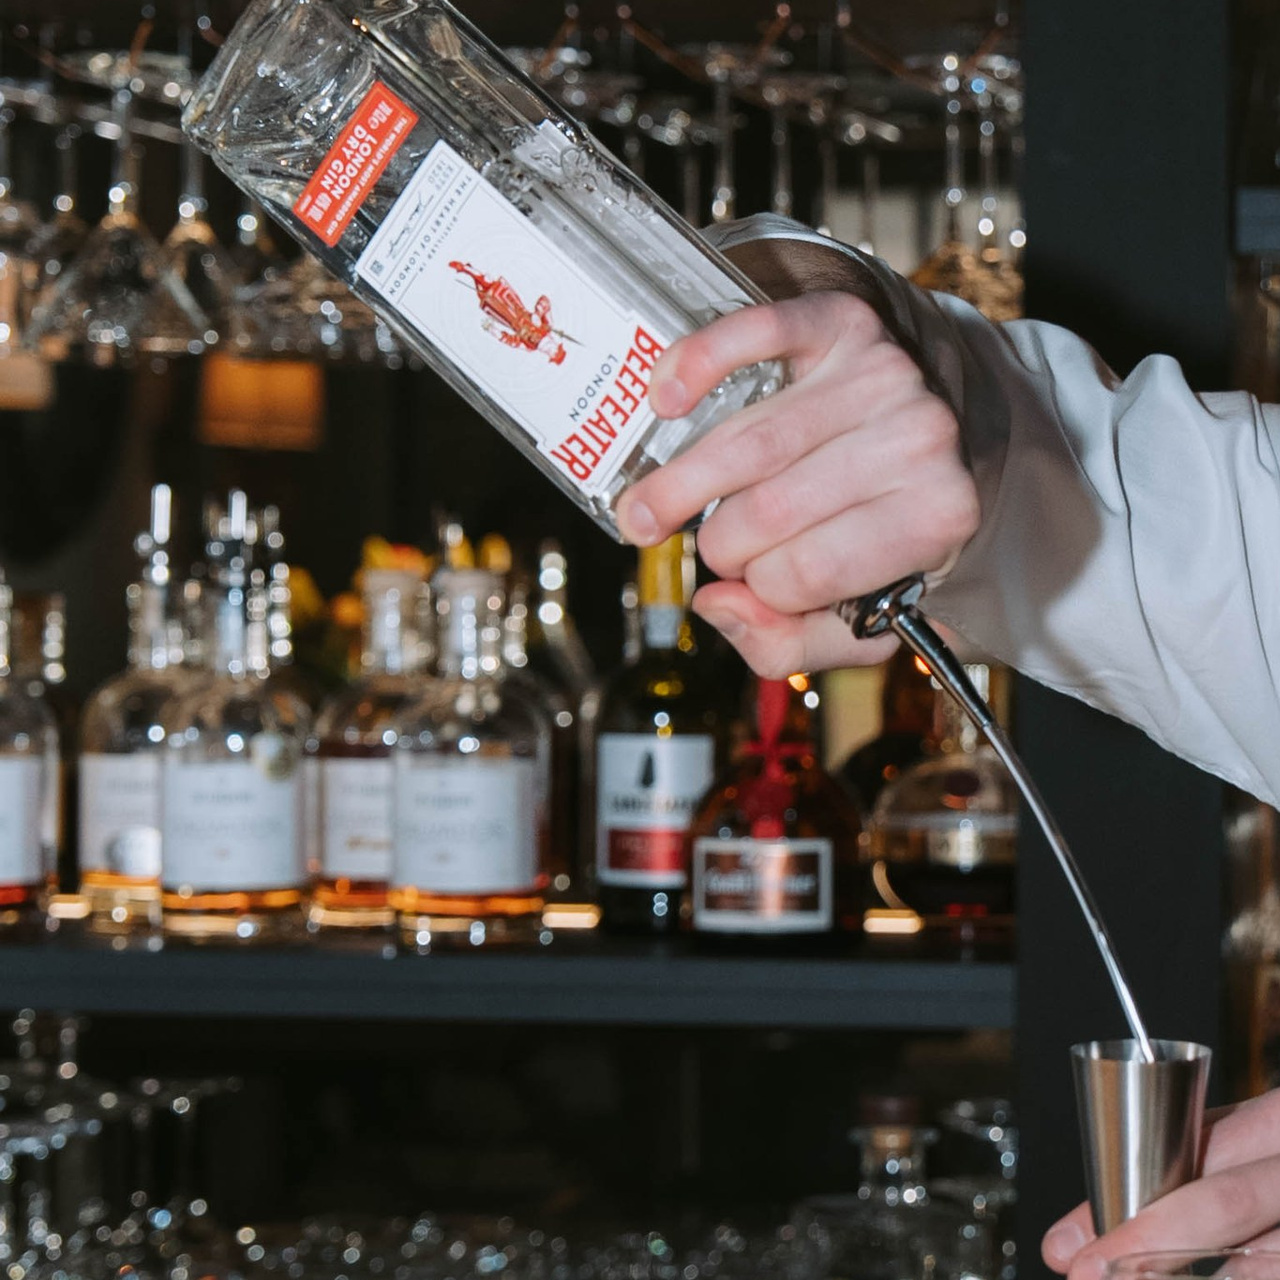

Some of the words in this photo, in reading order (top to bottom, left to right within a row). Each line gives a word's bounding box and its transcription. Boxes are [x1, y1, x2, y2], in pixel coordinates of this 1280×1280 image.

[341, 125, 367, 160] DRY
[395, 117, 408, 134] THE
[371, 133, 396, 165] WORLD'S
[320, 159, 344, 190] GIN
[331, 134, 378, 200] LONDON
[361, 165, 375, 187] MOST
[456, 175, 472, 196] THE
[337, 185, 361, 221] AWARDED
[432, 199, 454, 233] HEART
[326, 220, 339, 236] GIN
[420, 235, 431, 249] OF
[427, 216, 458, 260] DISTILLED
[389, 251, 421, 295] LONDON
[550, 325, 666, 481] BEEFEATER
[568, 354, 618, 421] LONDON
